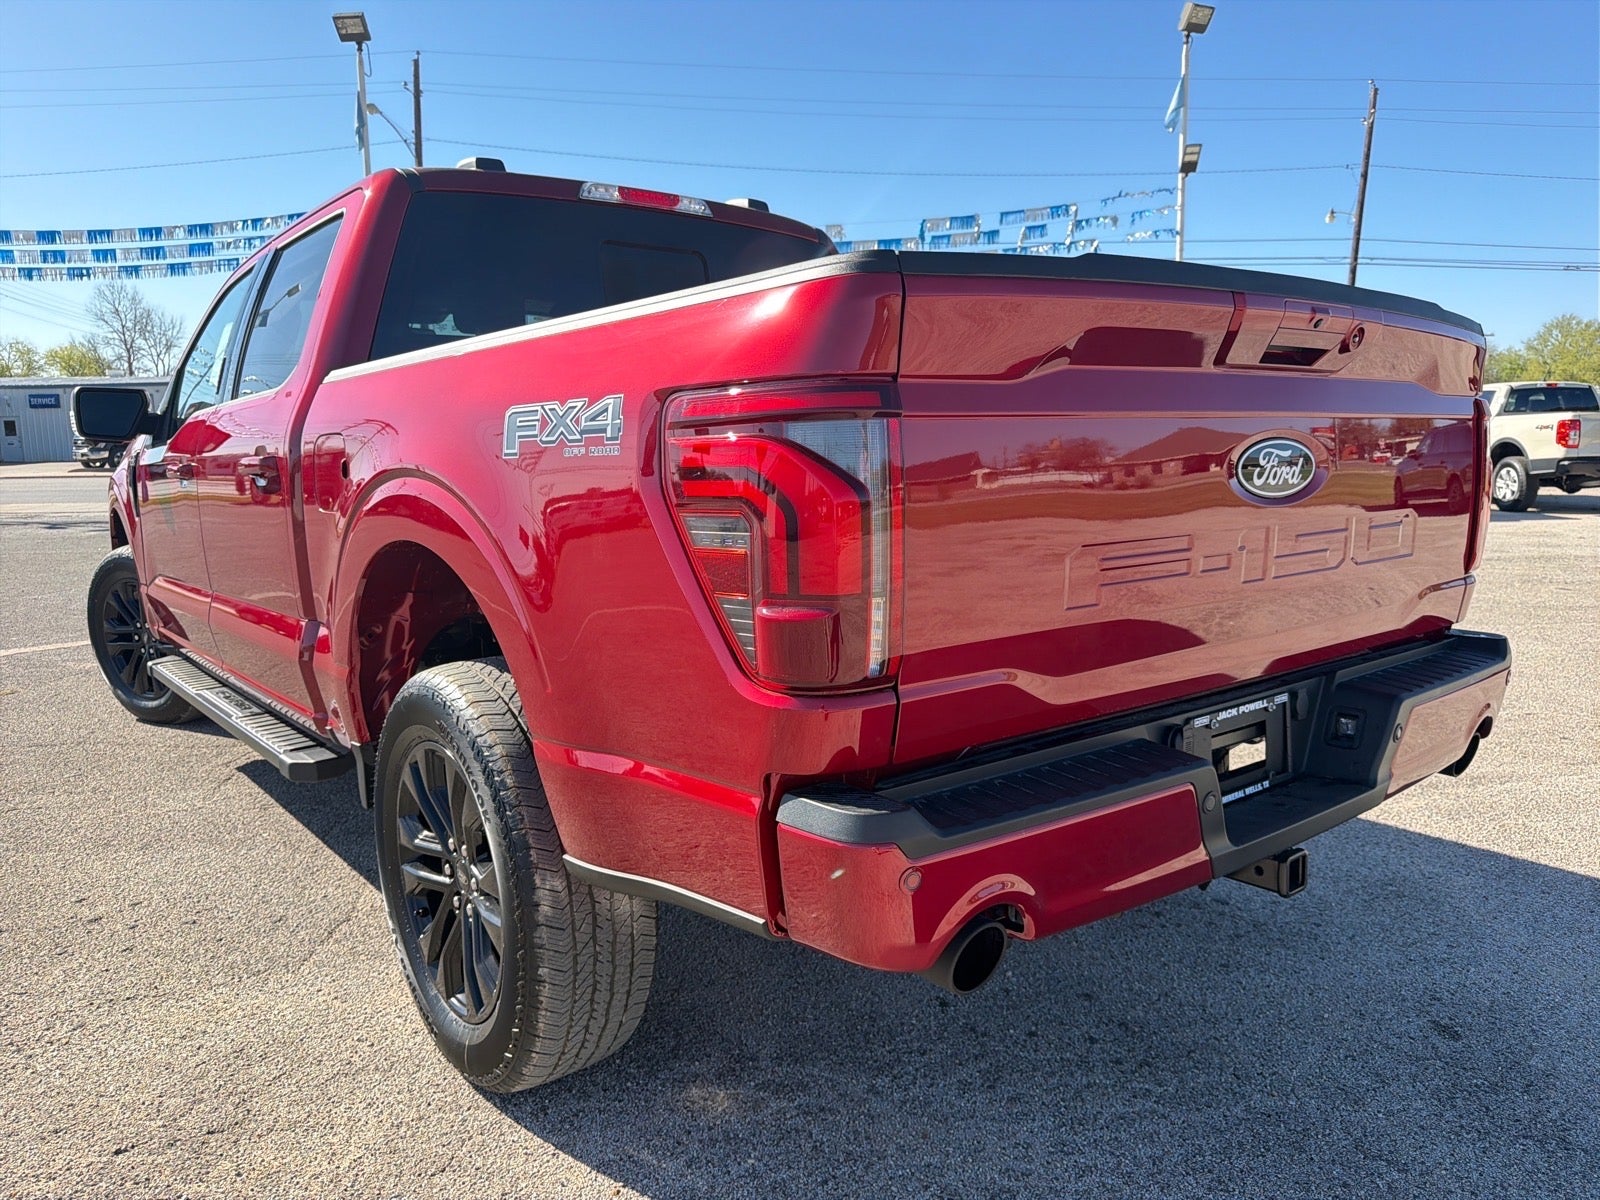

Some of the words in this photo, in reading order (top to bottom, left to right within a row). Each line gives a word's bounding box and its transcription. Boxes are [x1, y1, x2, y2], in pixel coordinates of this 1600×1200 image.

[30, 397, 56, 405] SERVICE
[502, 394, 624, 458] FX4
[563, 447, 586, 456] OFF
[589, 445, 621, 456] ROAD
[1252, 448, 1304, 487] Ford
[1064, 507, 1418, 611] F-150
[1217, 707, 1238, 721] JACK
[1239, 699, 1268, 715] POWELL
